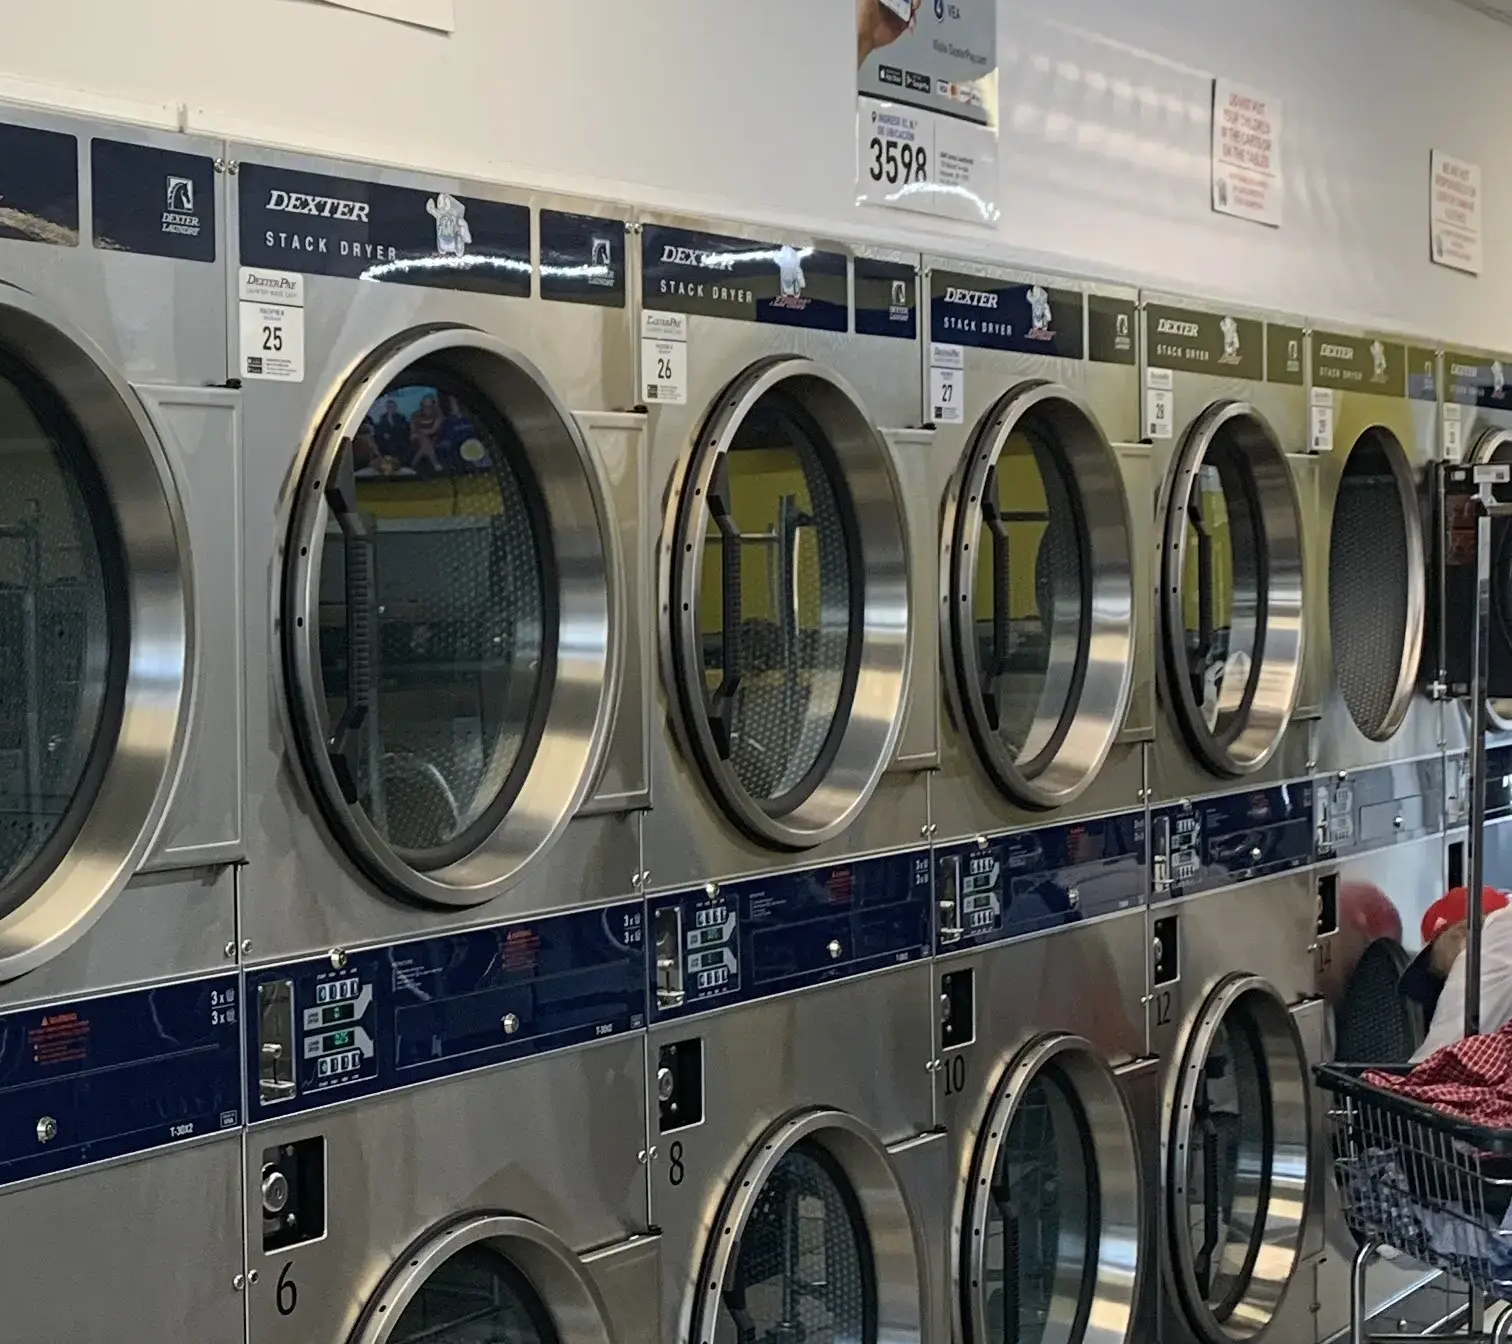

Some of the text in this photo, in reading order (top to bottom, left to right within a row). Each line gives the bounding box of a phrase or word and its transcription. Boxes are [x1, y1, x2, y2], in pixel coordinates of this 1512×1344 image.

[869, 137, 927, 184] 3598
[265, 189, 370, 223] DEXTER
[161, 212, 199, 226] DEXTER
[265, 230, 396, 261] STACK DRYER
[660, 279, 753, 303] STACK DRYER
[944, 287, 998, 309] DEXTER
[943, 316, 977, 332] STACK
[981, 321, 1013, 336] DRYER
[1157, 318, 1199, 337] DEXTER
[262, 326, 283, 351] 25
[1156, 344, 1182, 357] STACK
[657, 358, 672, 379] 26
[941, 384, 953, 403] 27
[210, 990, 218, 1006] 3
[1156, 990, 1171, 1026] 12
[211, 1010, 219, 1025] 3
[944, 1054, 965, 1096] 10
[669, 1140, 685, 1186] 8
[276, 1260, 298, 1316] 6
